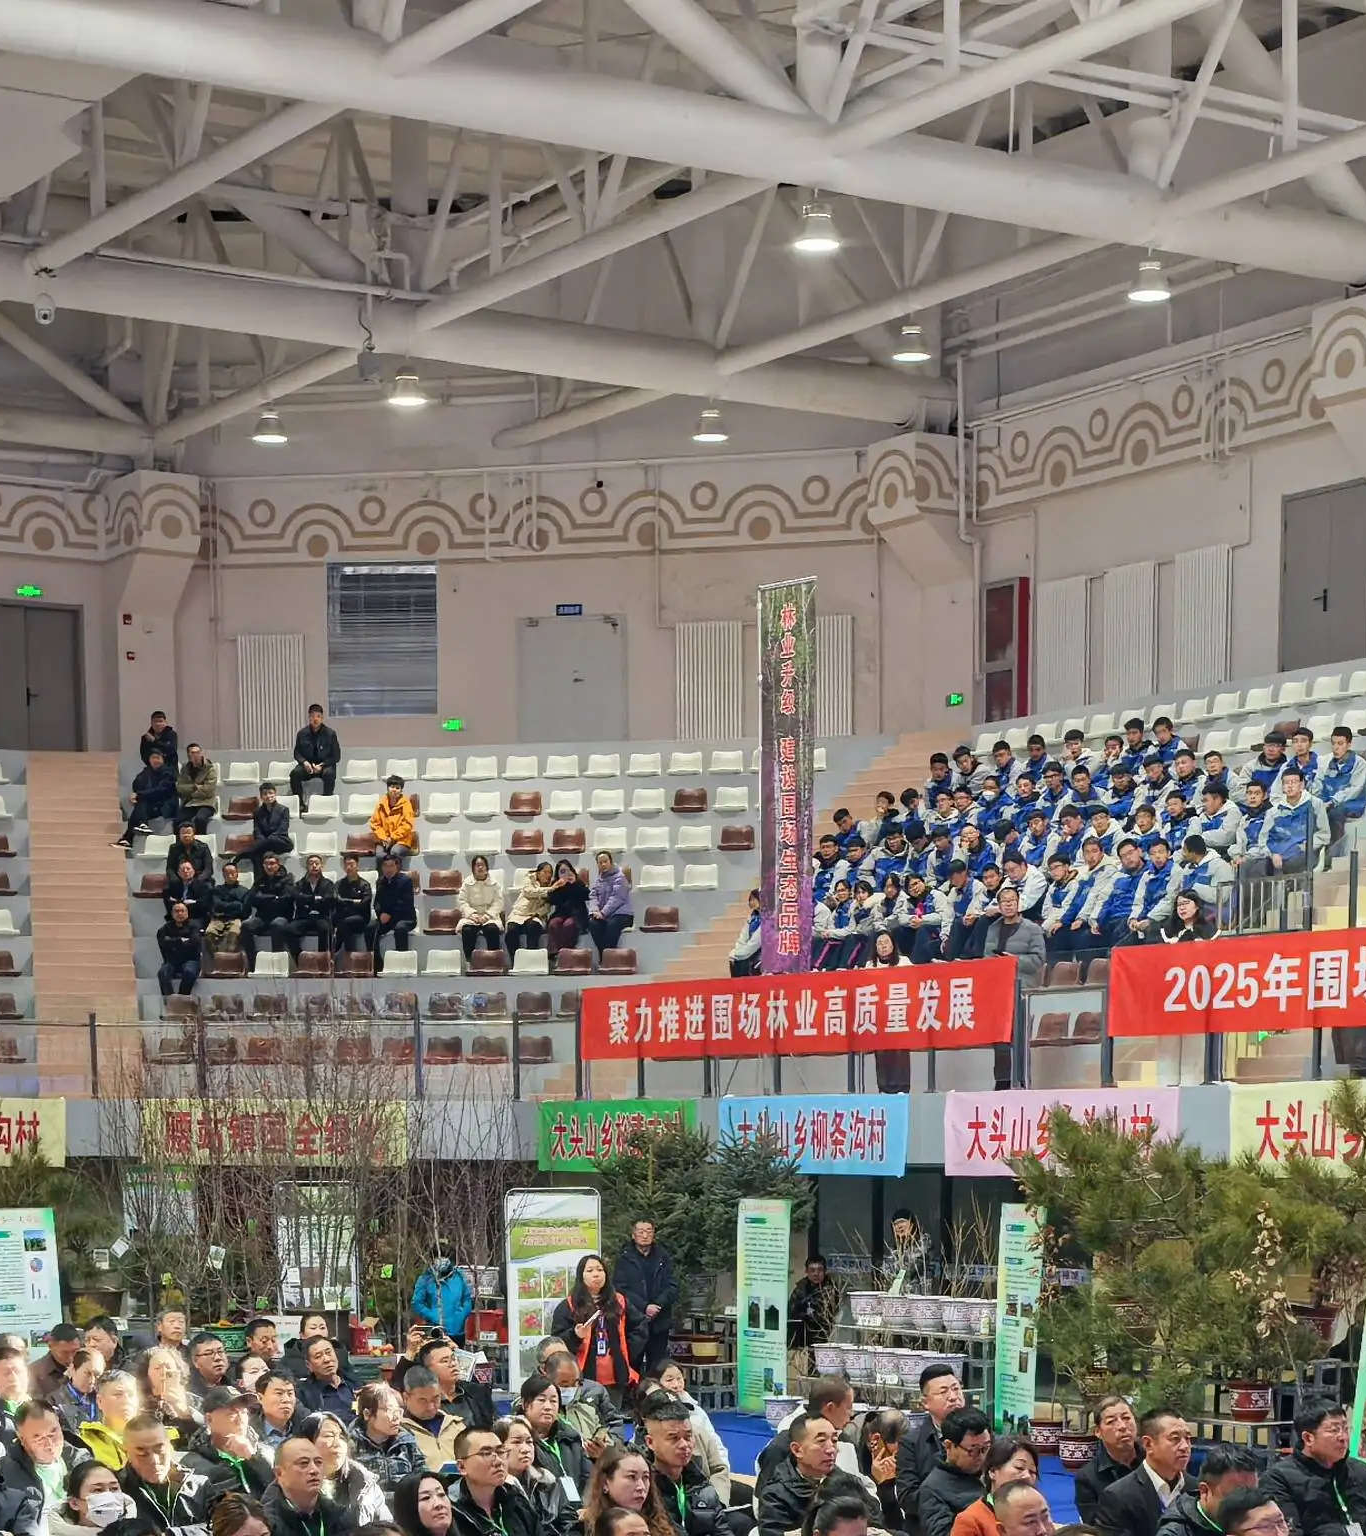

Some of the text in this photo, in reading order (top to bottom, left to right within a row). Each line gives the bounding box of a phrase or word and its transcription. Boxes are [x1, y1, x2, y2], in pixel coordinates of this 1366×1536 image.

[778, 601, 801, 955] 林业升级 建设围场生态品牌
[607, 975, 976, 1046] 聚力推进围场林业高质量发展
